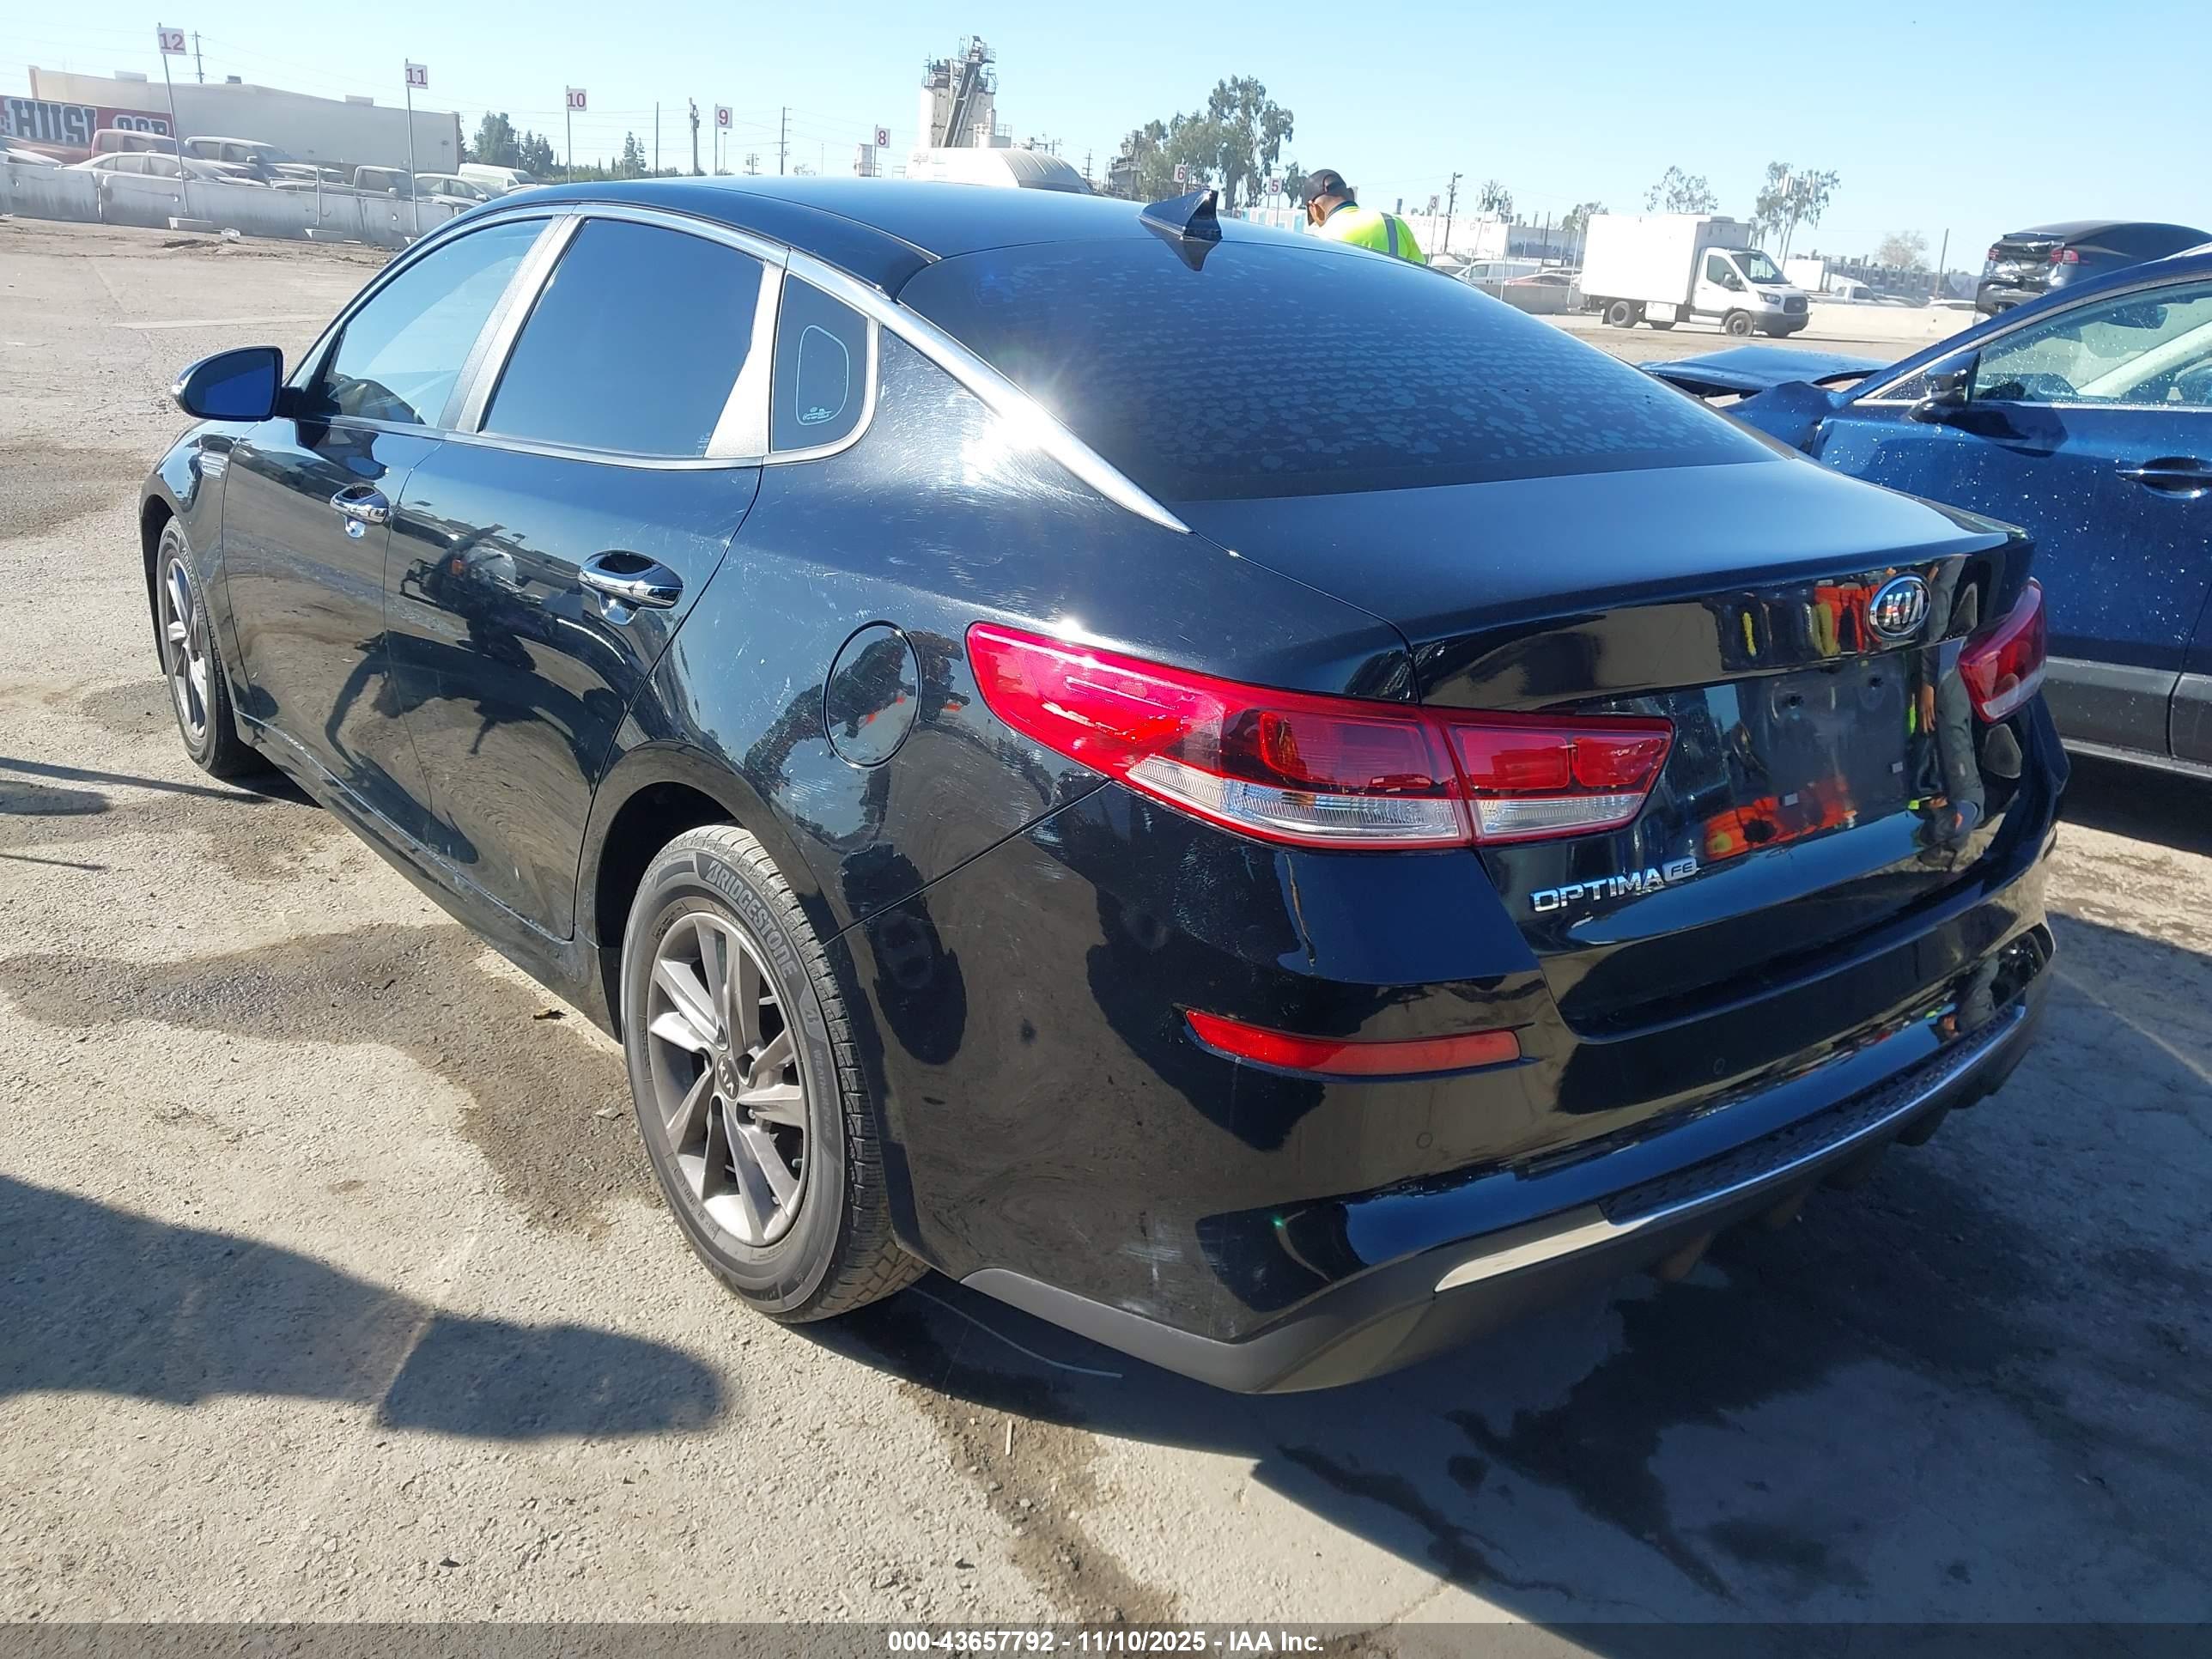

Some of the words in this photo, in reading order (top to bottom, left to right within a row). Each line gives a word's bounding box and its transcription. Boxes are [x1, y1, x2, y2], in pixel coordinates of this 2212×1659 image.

[159, 33, 185, 52] 12
[405, 68, 428, 85] 11
[567, 92, 586, 107] 10
[719, 109, 729, 125] 9
[878, 130, 887, 146] 8
[1177, 167, 1186, 180] 6
[1271, 179, 1279, 193] 5
[1883, 590, 1925, 626] KIA
[1530, 867, 1665, 913] OPTIMA
[1670, 861, 1693, 878] FE
[704, 860, 799, 979] BRIDGESTONE
[718, 1060, 735, 1096] KIA
